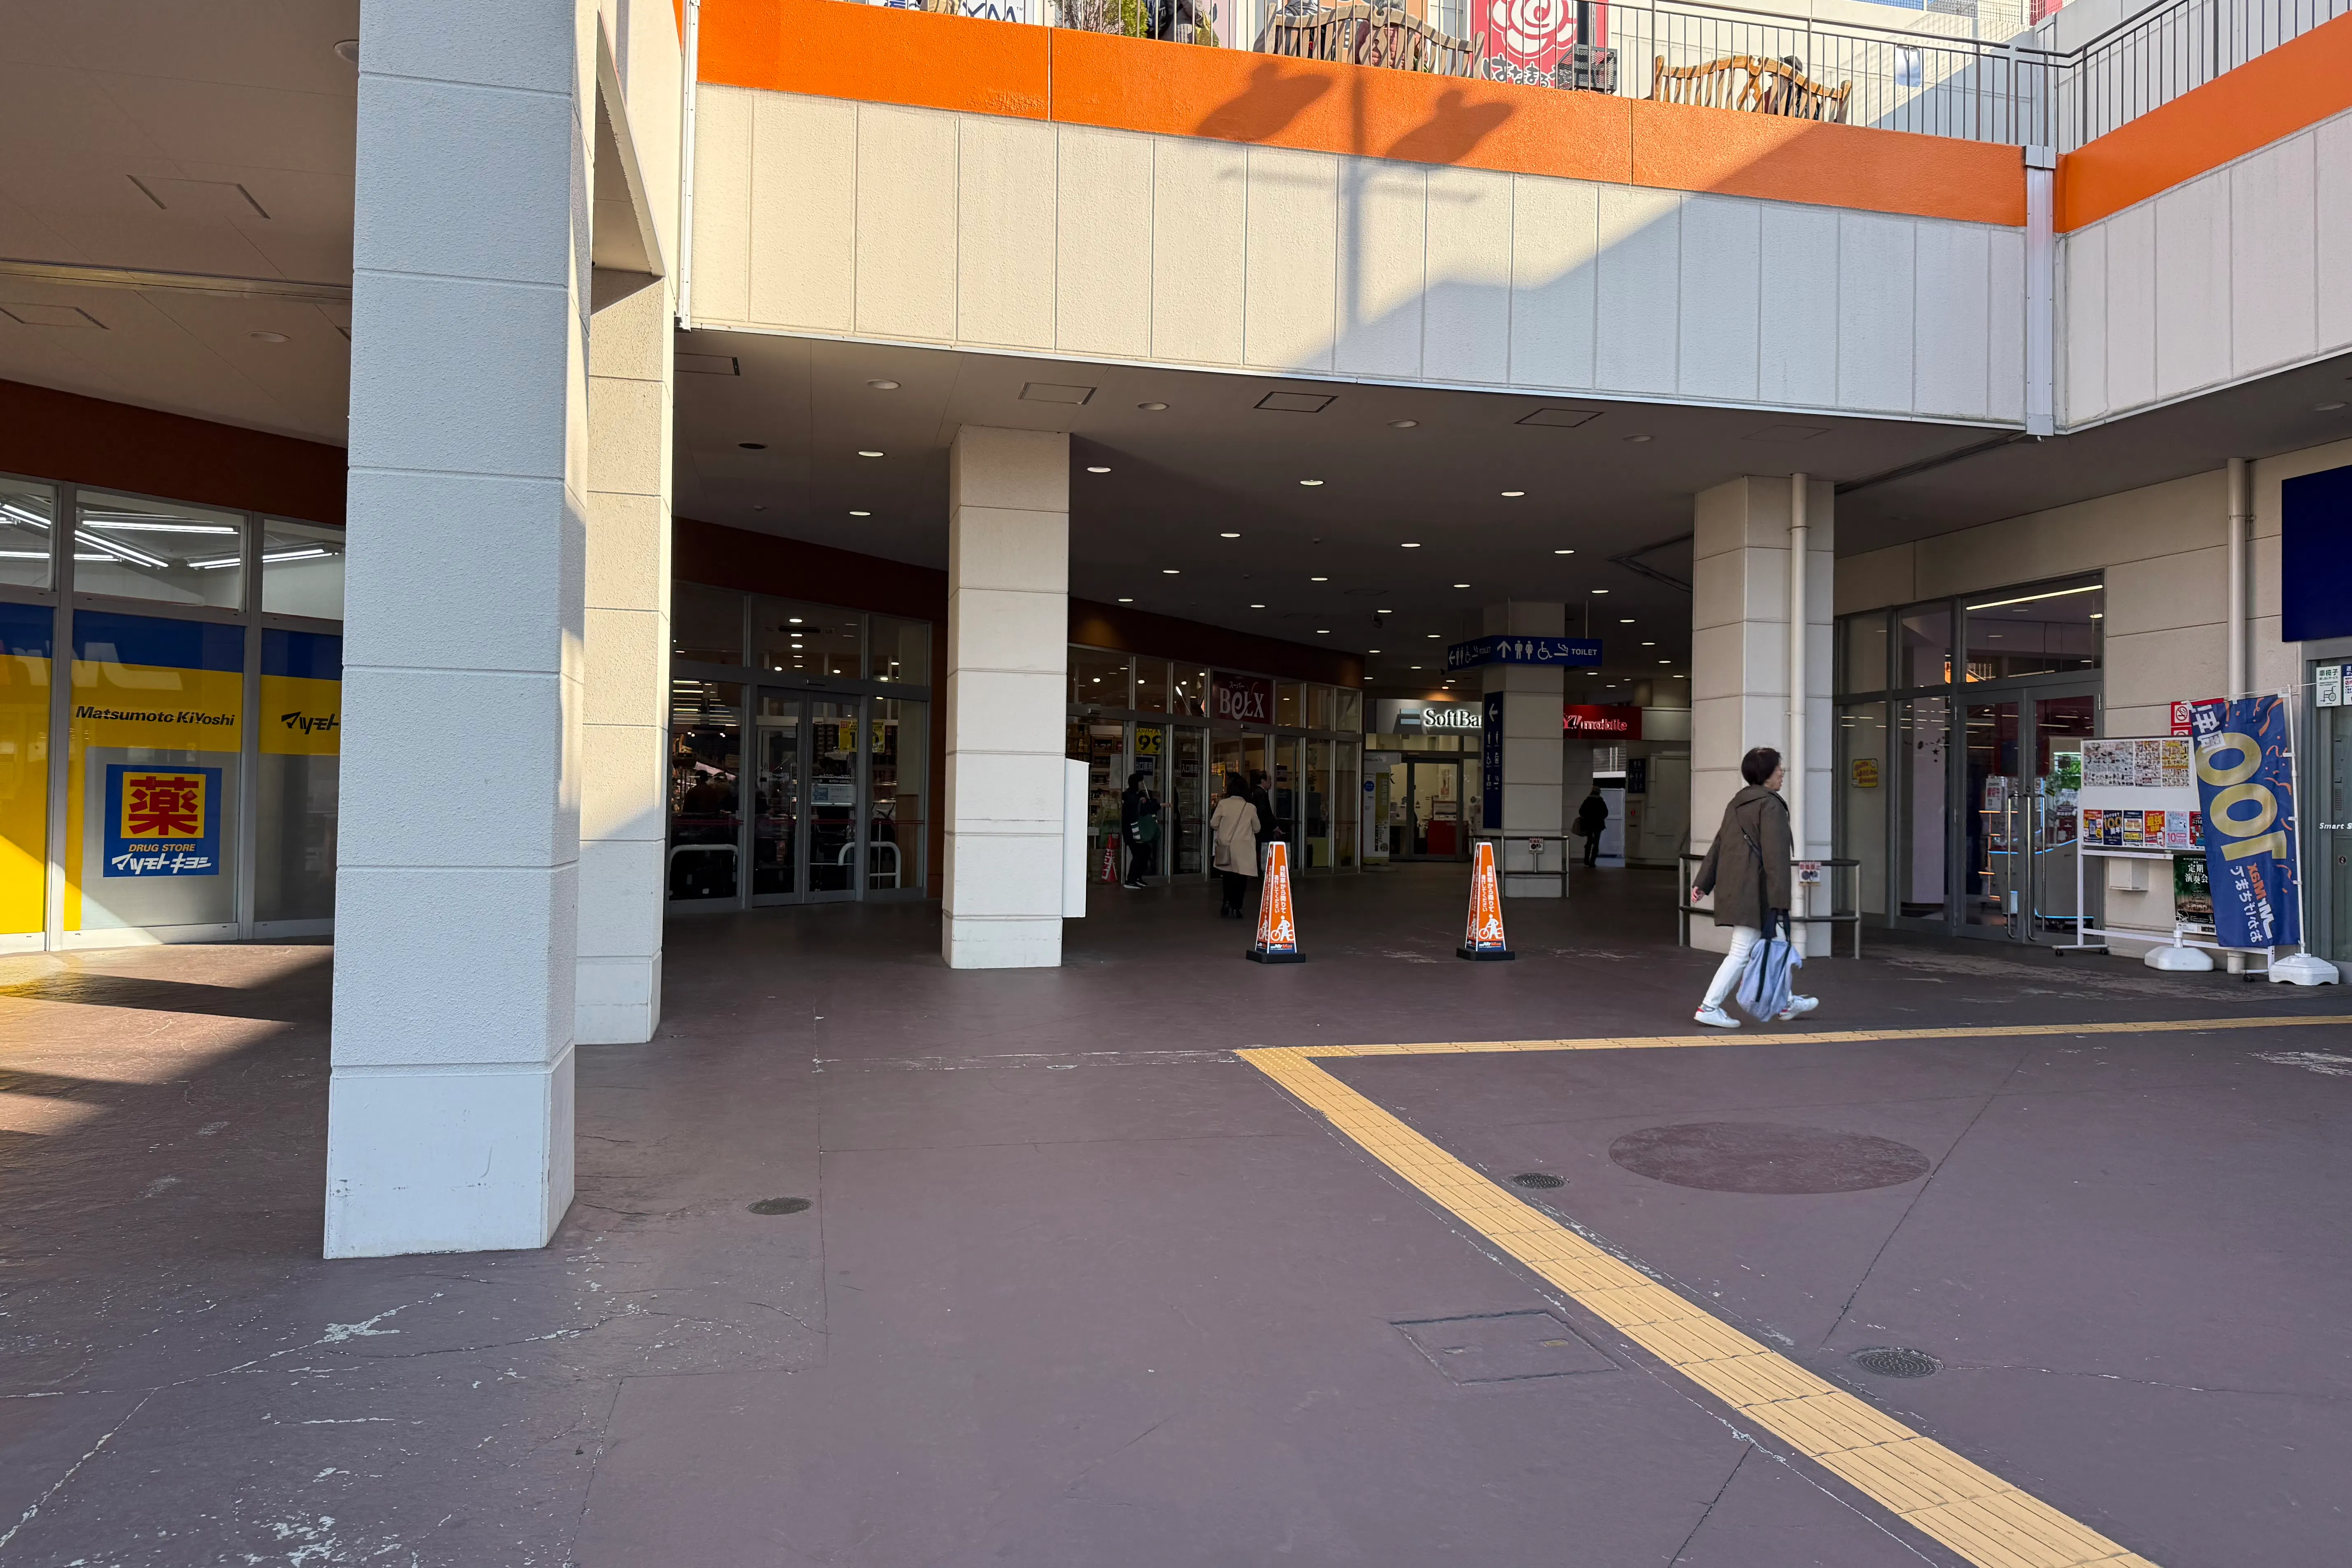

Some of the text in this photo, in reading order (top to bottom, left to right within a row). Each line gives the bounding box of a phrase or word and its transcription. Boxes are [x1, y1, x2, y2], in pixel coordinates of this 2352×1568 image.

[1229, 681, 1245, 690] スーパー
[76, 706, 235, 726] Matsumoto KiYoshi
[1425, 709, 1482, 726] SoftBa
[128, 776, 199, 835] 薬
[128, 844, 196, 852] DRUG STORE
[112, 853, 211, 874] マツモトキヨシ
[2188, 864, 2204, 873] 定期
[2185, 874, 2208, 884] 演奏会
